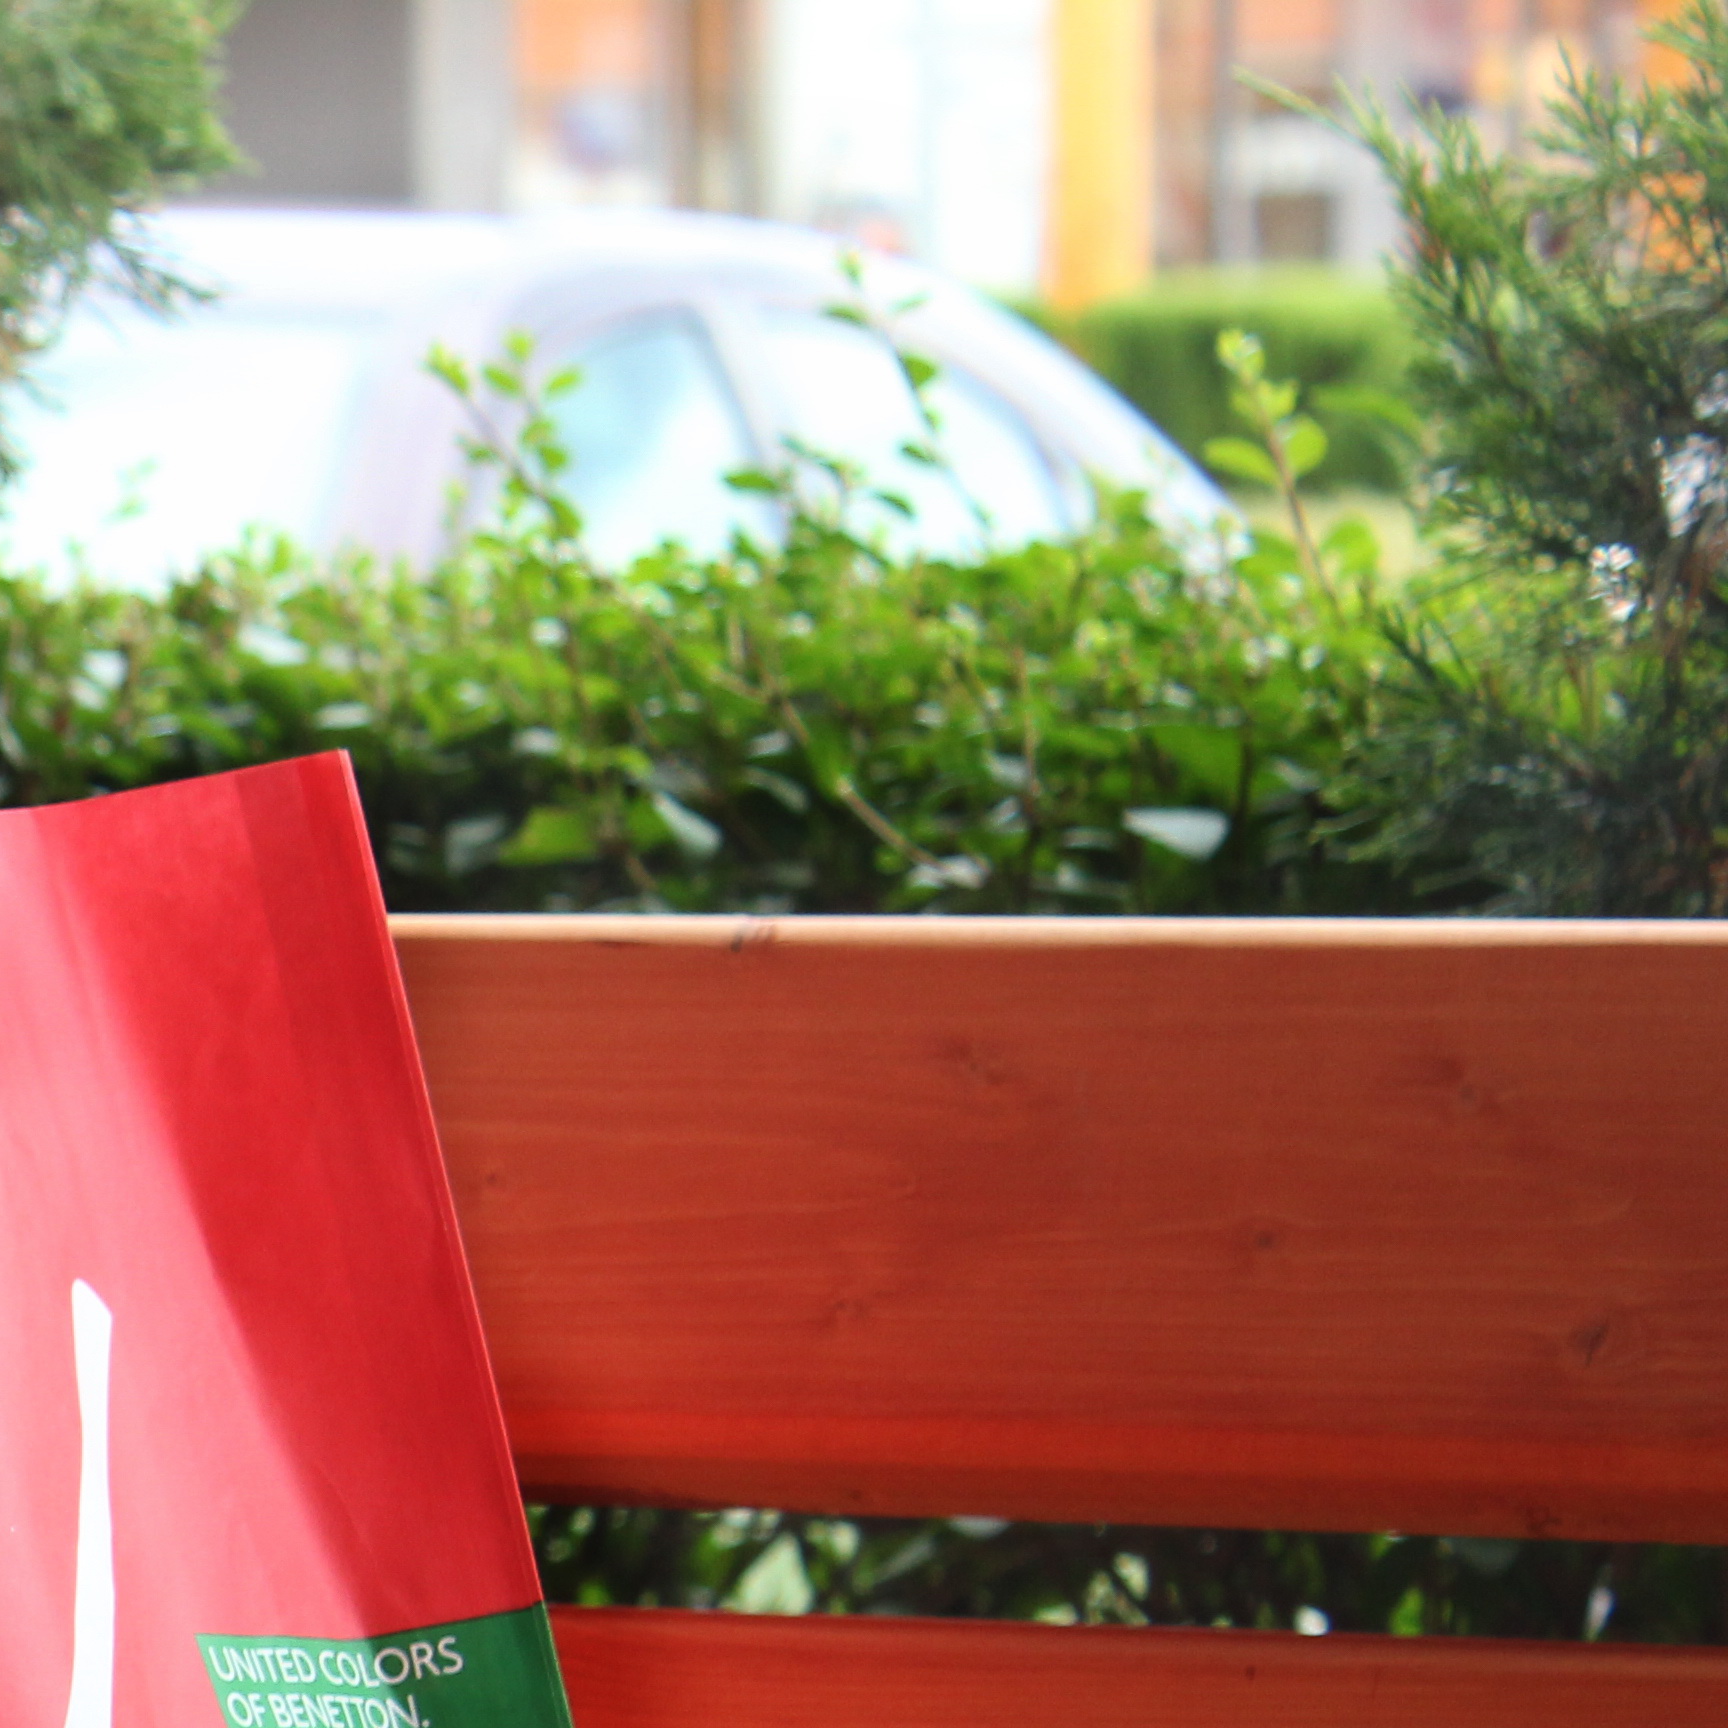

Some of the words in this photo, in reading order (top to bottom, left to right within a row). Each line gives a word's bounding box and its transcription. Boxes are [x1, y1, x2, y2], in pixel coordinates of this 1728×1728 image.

[208, 1645, 317, 1684] UNITED
[318, 1636, 465, 1688] COLORS
[226, 1691, 267, 1728] OF
